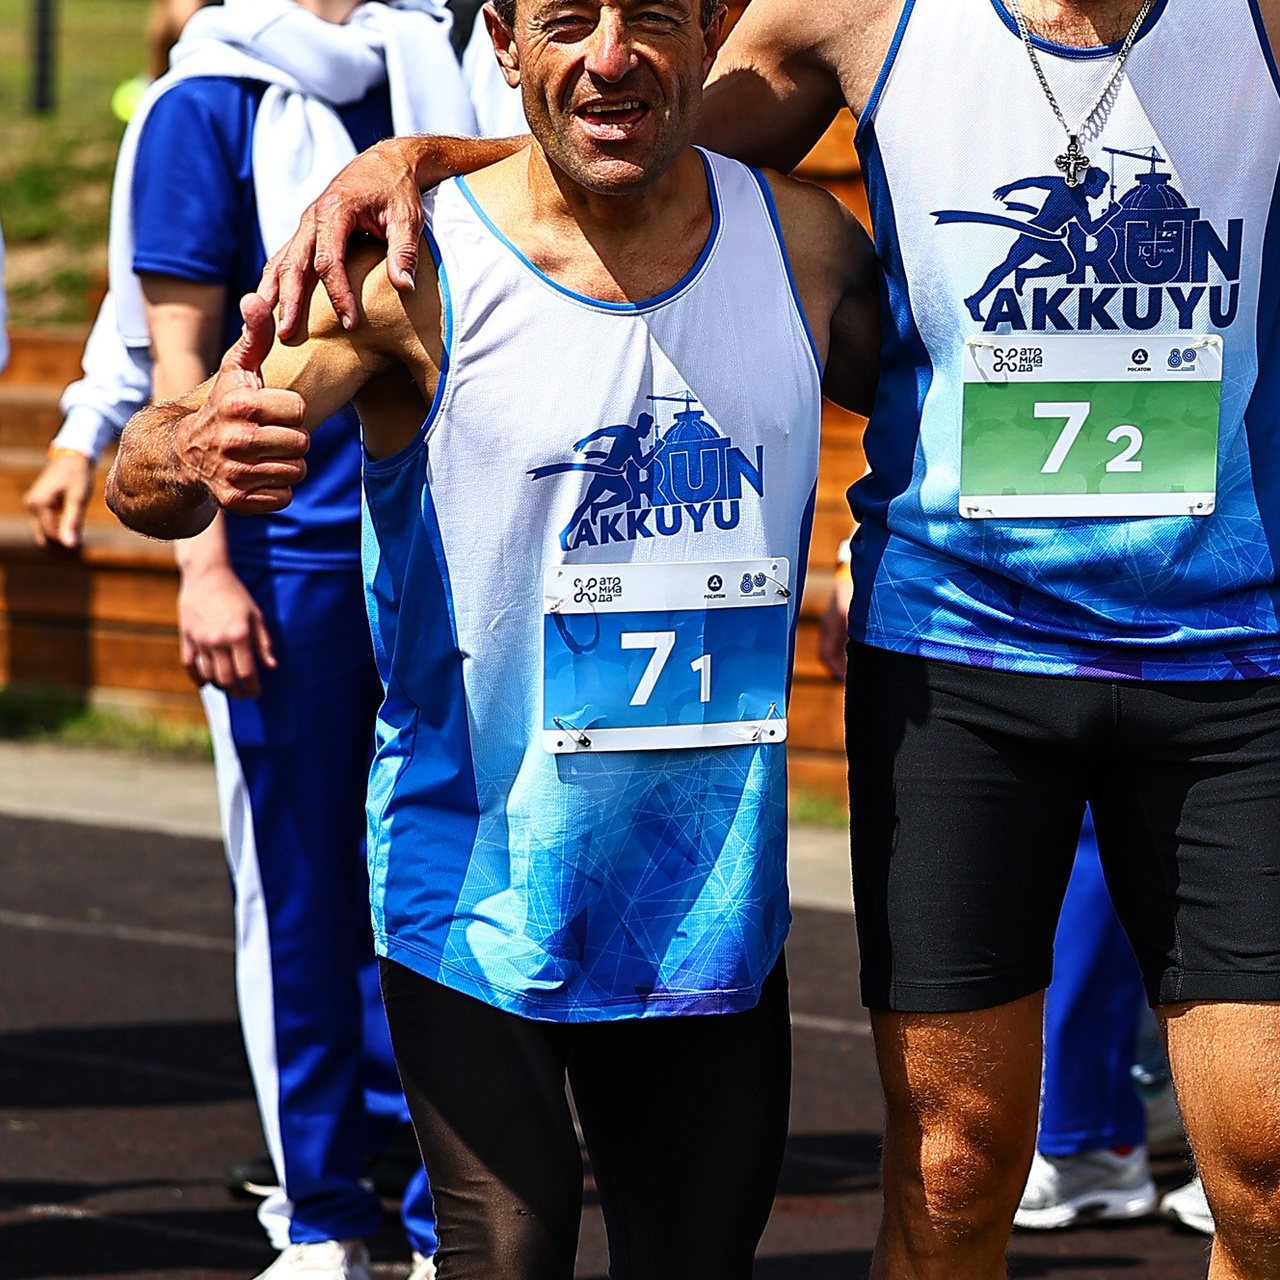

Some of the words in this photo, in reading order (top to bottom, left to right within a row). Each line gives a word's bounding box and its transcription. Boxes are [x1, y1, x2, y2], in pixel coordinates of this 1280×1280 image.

[1066, 218, 1244, 284] RUN
[983, 282, 1241, 332] AKKUYU
[1033, 401, 1090, 474] 7
[1105, 425, 1144, 472] 2
[627, 444, 764, 510] RUN
[571, 499, 740, 549] AKKUYU
[620, 631, 675, 706] 7
[690, 654, 712, 703] 1
